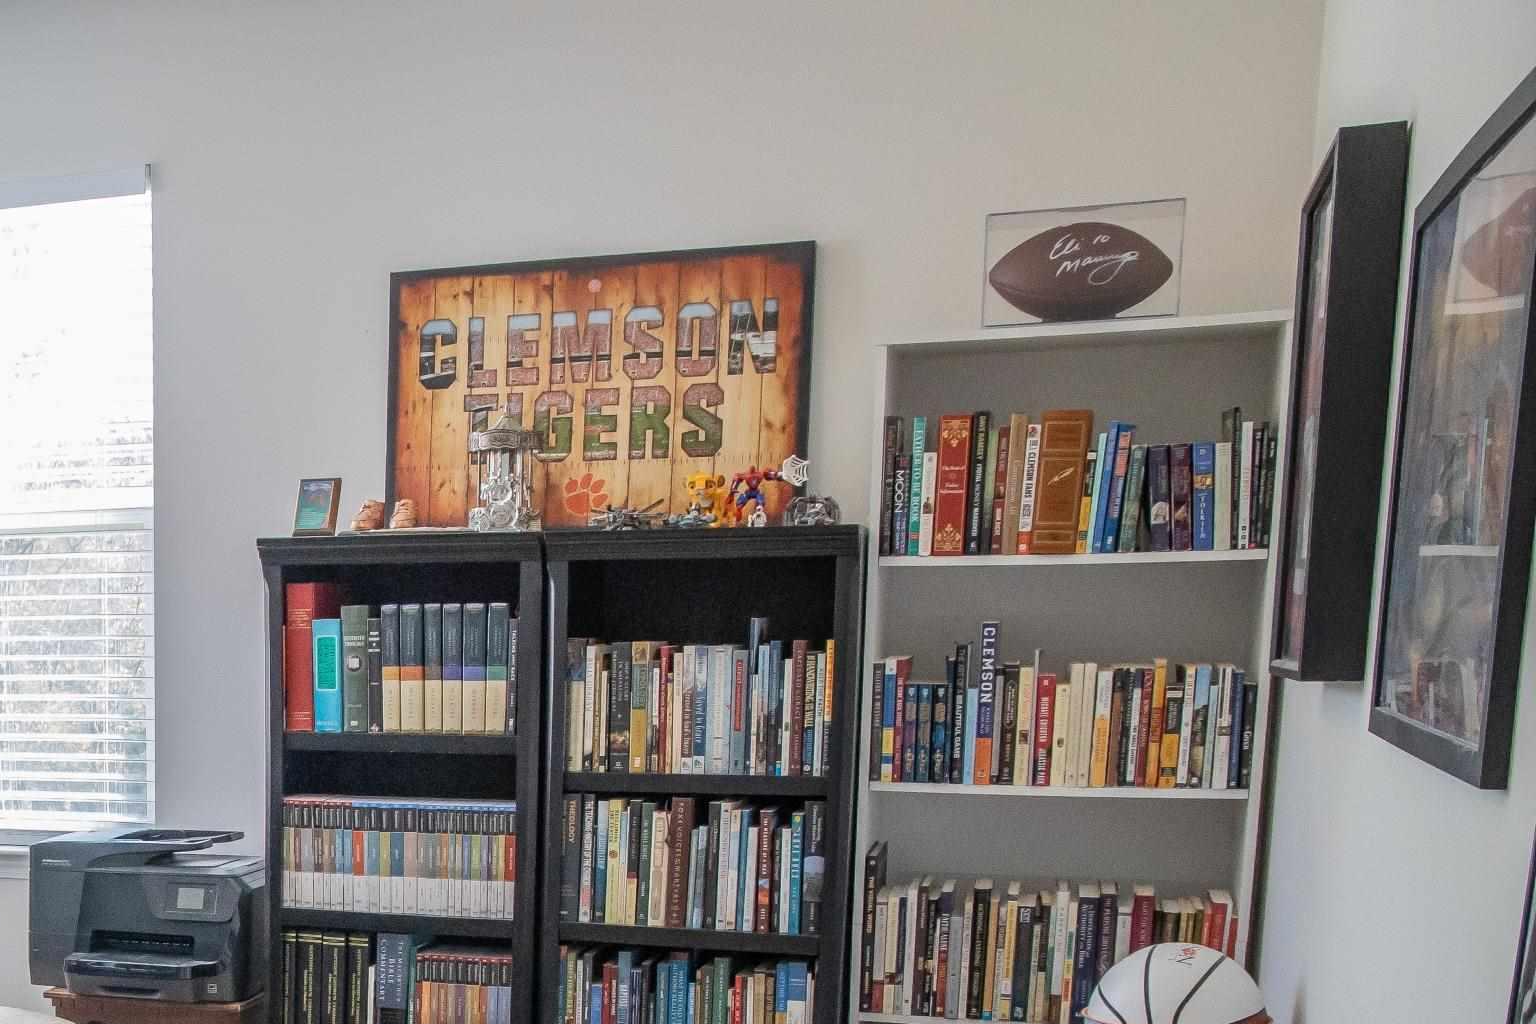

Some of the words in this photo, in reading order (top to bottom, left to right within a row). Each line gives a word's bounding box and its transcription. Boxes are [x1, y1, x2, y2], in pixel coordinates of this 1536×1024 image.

[419, 297, 780, 390] CLEMSON
[912, 429, 922, 465] FATHER
[912, 467, 922, 479] TO
[1026, 452, 1035, 480] CLEMSON
[894, 470, 904, 512] MOON
[912, 483, 921, 494] BE
[1024, 482, 1033, 498] FANS
[911, 496, 921, 522] BOOK
[980, 627, 996, 703] CLEMSON
[804, 711, 814, 727] WALL
[954, 695, 963, 736] AUTIFUL
[953, 737, 961, 758] GAME
[568, 800, 576, 843] THEOLOGY
[378, 939, 387, 1001] COMMENTARY
[387, 958, 395, 985] BIBLE
